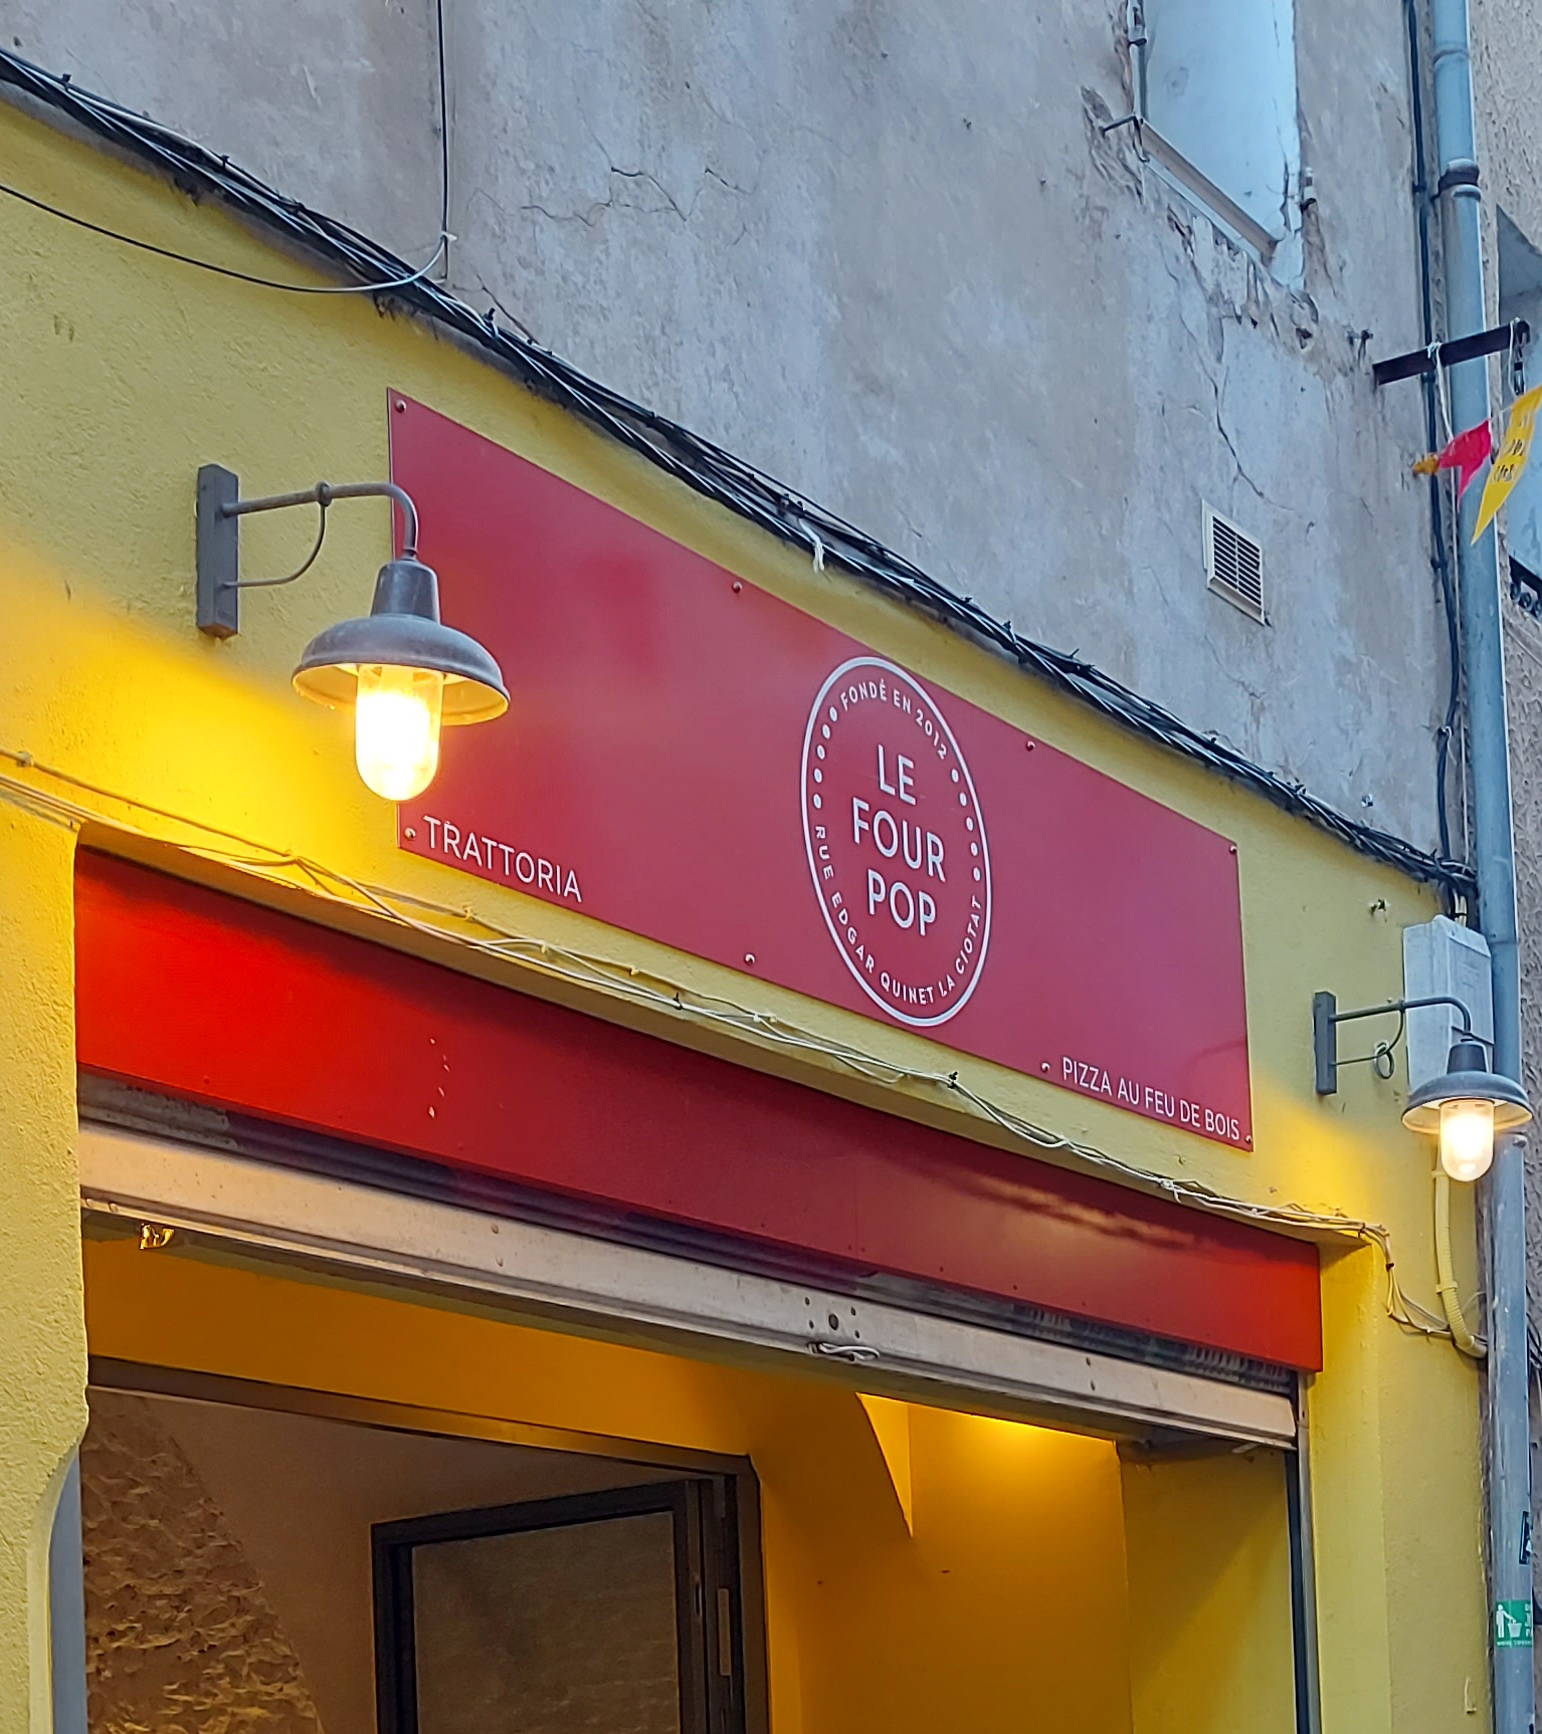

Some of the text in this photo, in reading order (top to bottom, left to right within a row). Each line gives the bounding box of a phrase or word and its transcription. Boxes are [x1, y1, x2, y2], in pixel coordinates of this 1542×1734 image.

[840, 678, 947, 760] FONDÉ EN 2012
[877, 743, 917, 806] LE
[422, 814, 582, 903] TRATTORIA
[852, 796, 946, 883] FOUR
[814, 825, 982, 1006] RUE EDGAR QUINET LA CIOTAT
[867, 868, 936, 937] POP
[1062, 1056, 1240, 1141] PIZZA AU FEU DE BOIS
